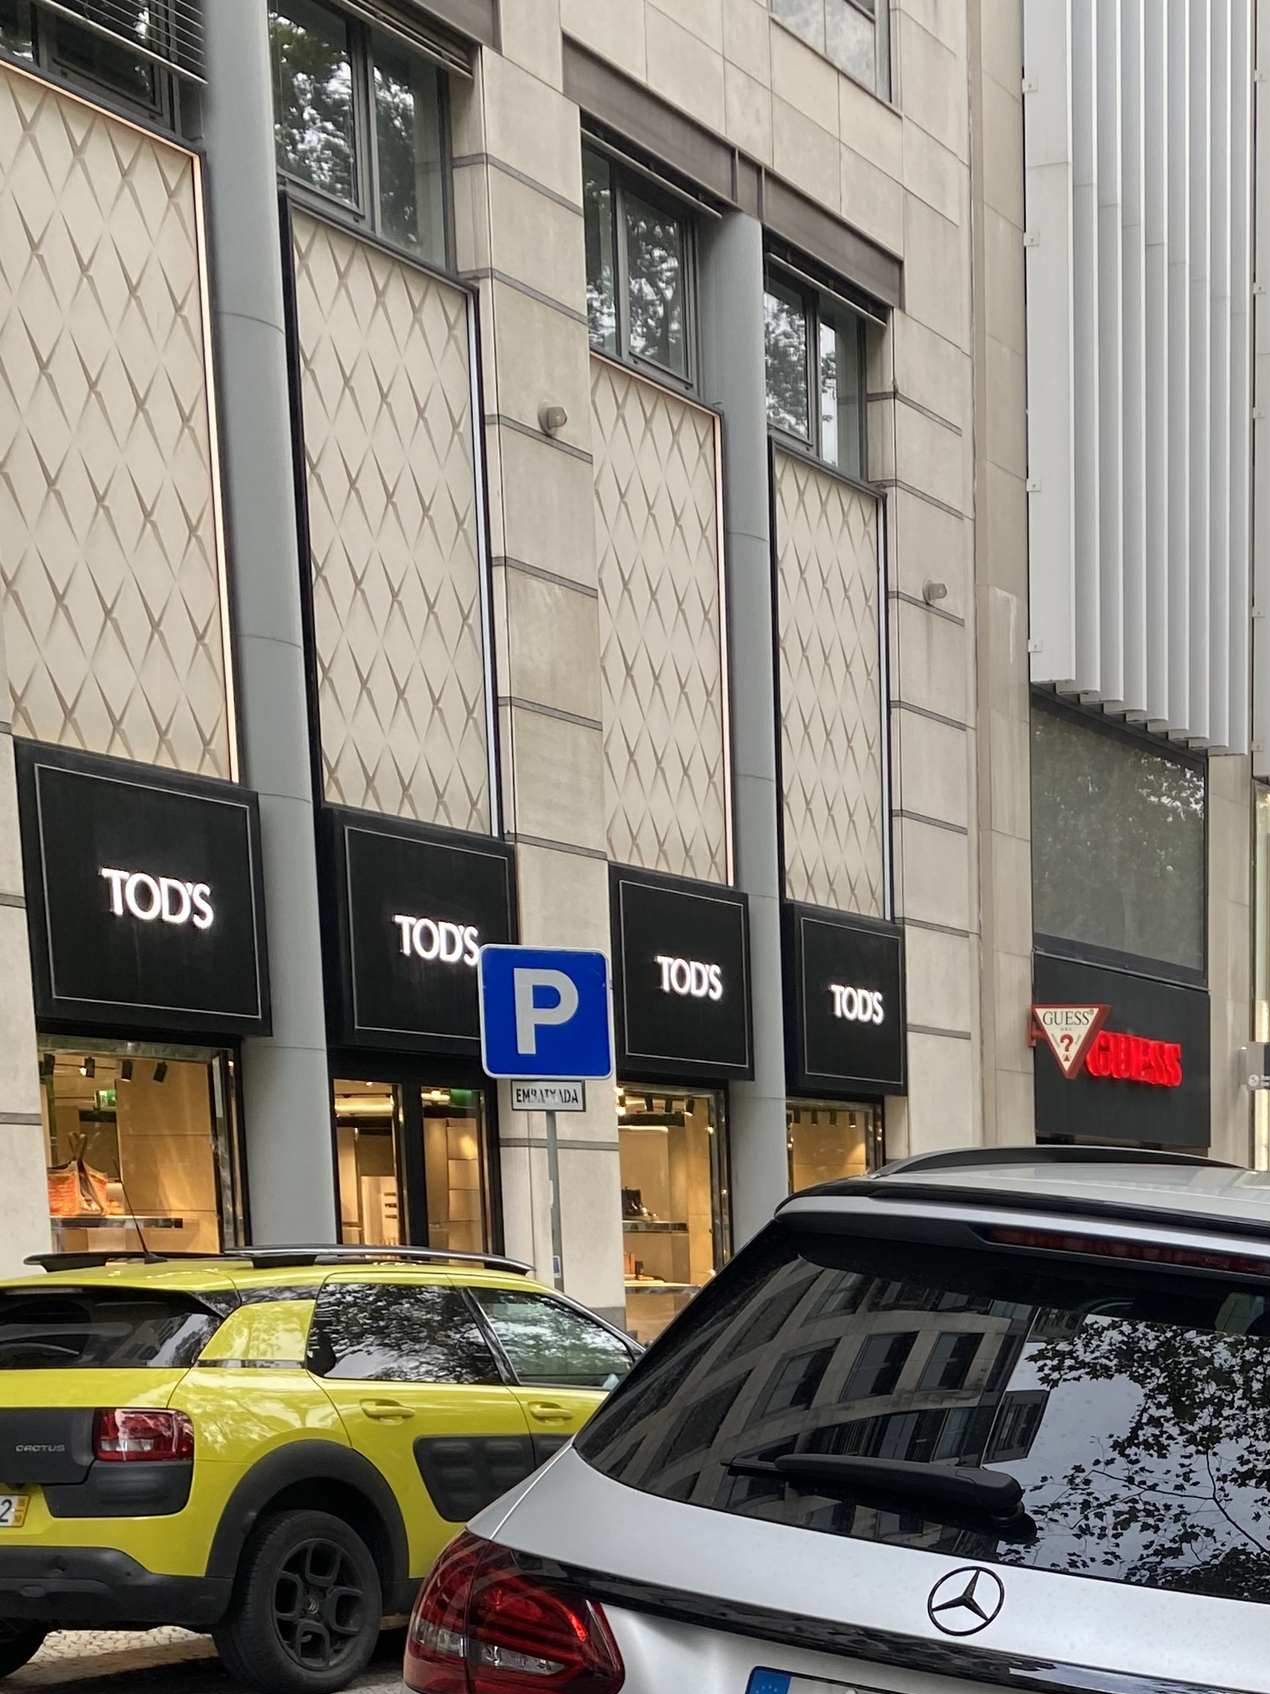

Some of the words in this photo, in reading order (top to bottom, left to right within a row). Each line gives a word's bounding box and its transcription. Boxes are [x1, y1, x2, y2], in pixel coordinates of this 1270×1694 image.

[102, 868, 214, 929] TOD'S
[394, 915, 479, 966] TOD'S
[656, 955, 724, 1001] TOD'S
[513, 967, 579, 1055] P
[829, 984, 885, 1026] TOD'S
[1042, 1010, 1090, 1026] GUESS
[1087, 1031, 1182, 1087] GUESS
